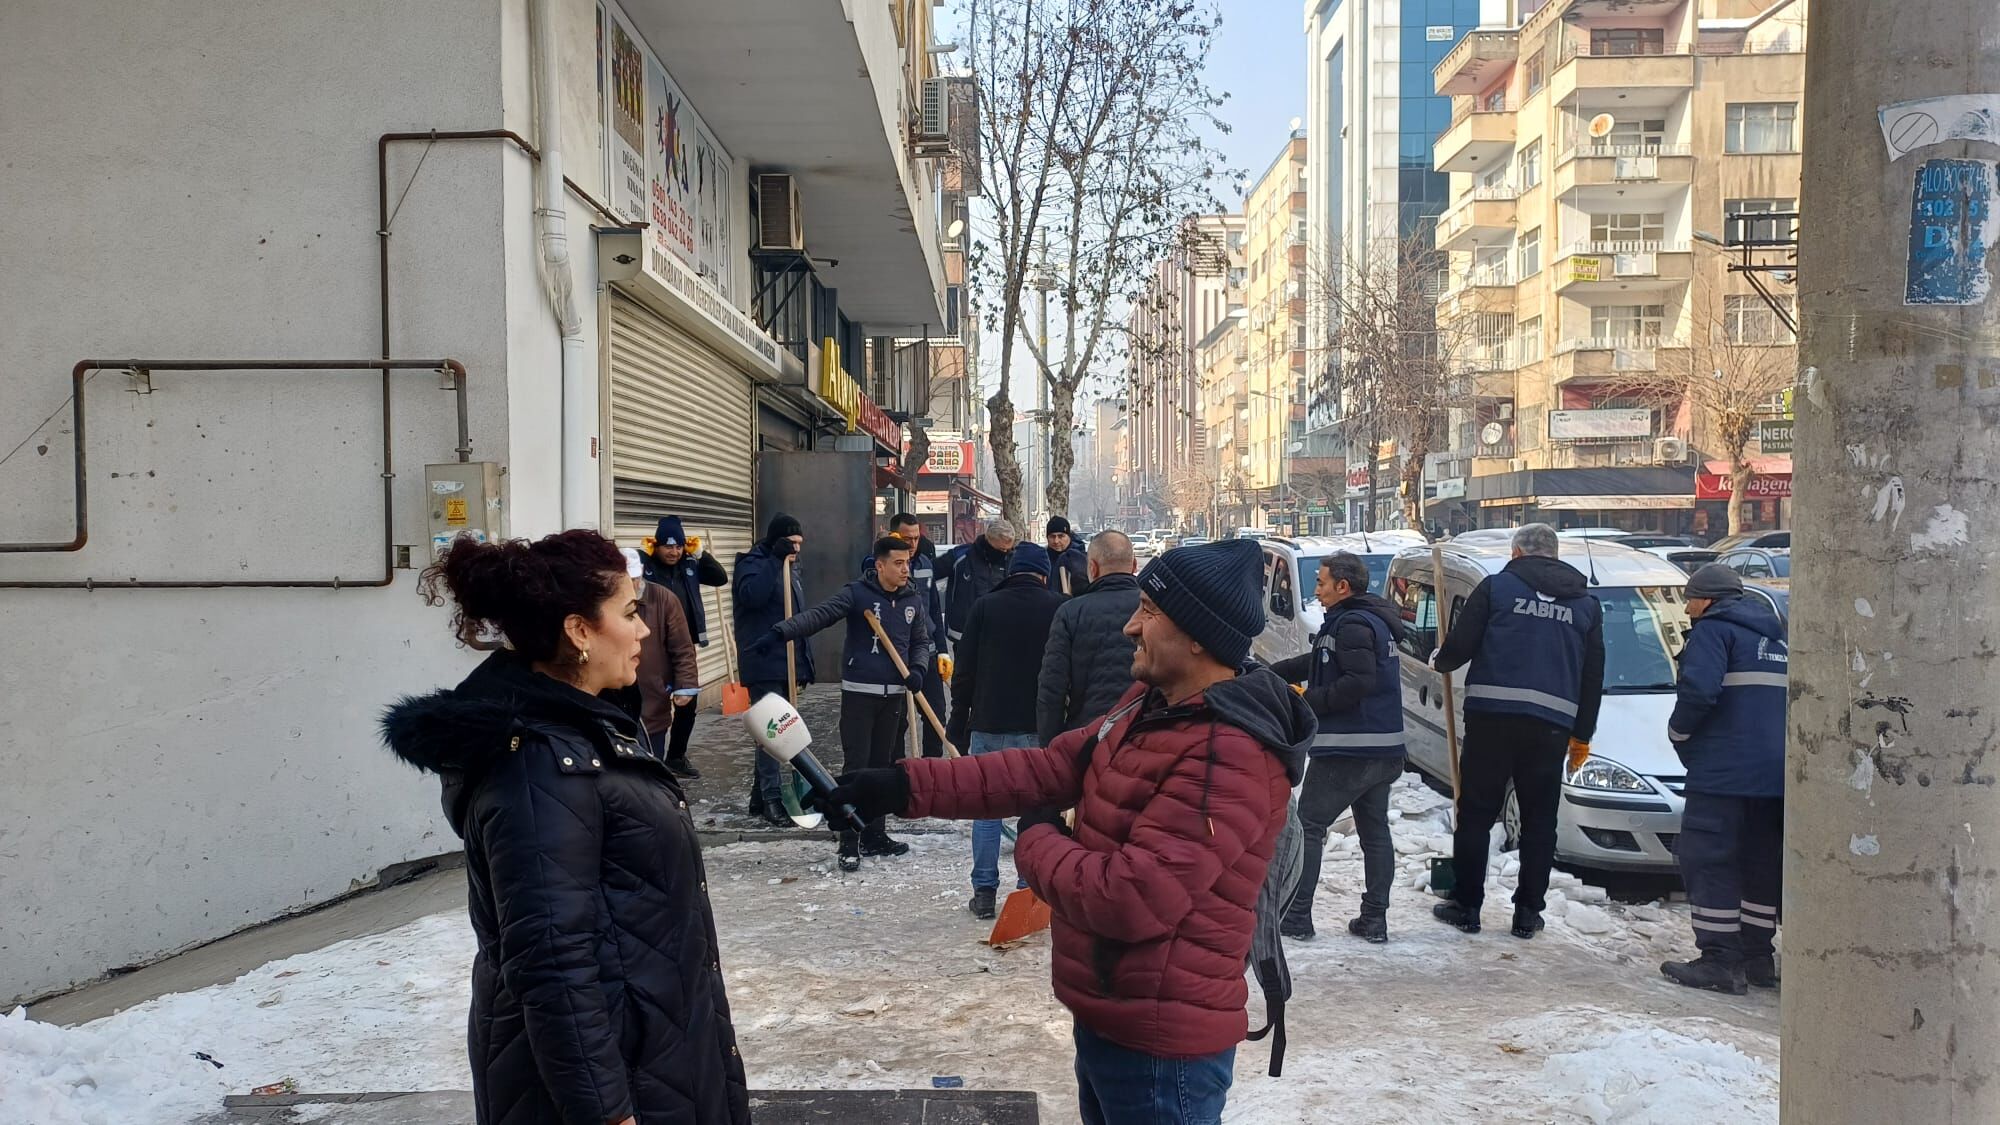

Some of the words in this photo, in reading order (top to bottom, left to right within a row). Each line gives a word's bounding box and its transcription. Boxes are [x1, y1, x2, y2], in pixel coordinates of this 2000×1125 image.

[929, 450, 959, 458] DAHA
[929, 458, 959, 466] DAHA
[1513, 597, 1573, 625] ZABITA
